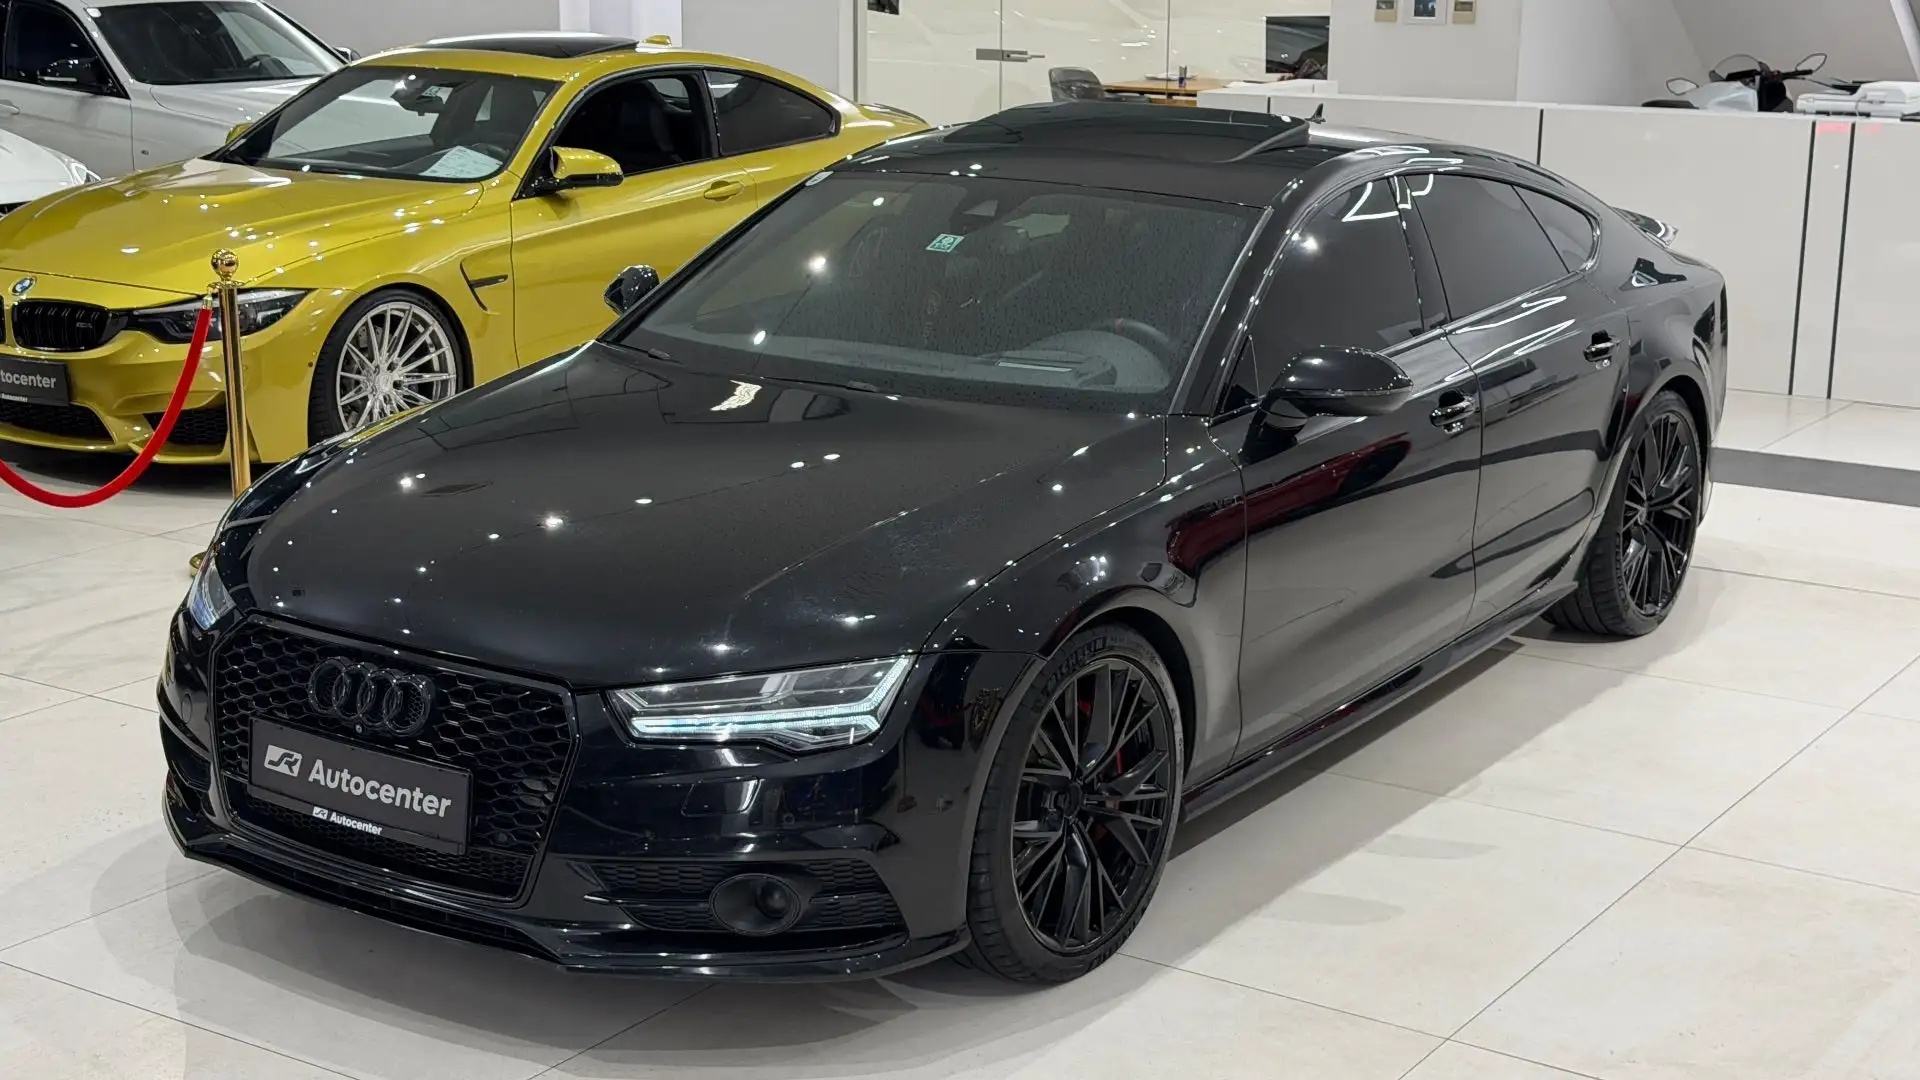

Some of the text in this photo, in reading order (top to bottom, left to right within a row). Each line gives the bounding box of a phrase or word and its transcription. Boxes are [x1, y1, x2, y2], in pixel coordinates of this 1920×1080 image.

[0, 369, 56, 388] tocenter
[308, 758, 452, 818] Autocenter
[330, 811, 382, 836] Autocenter
